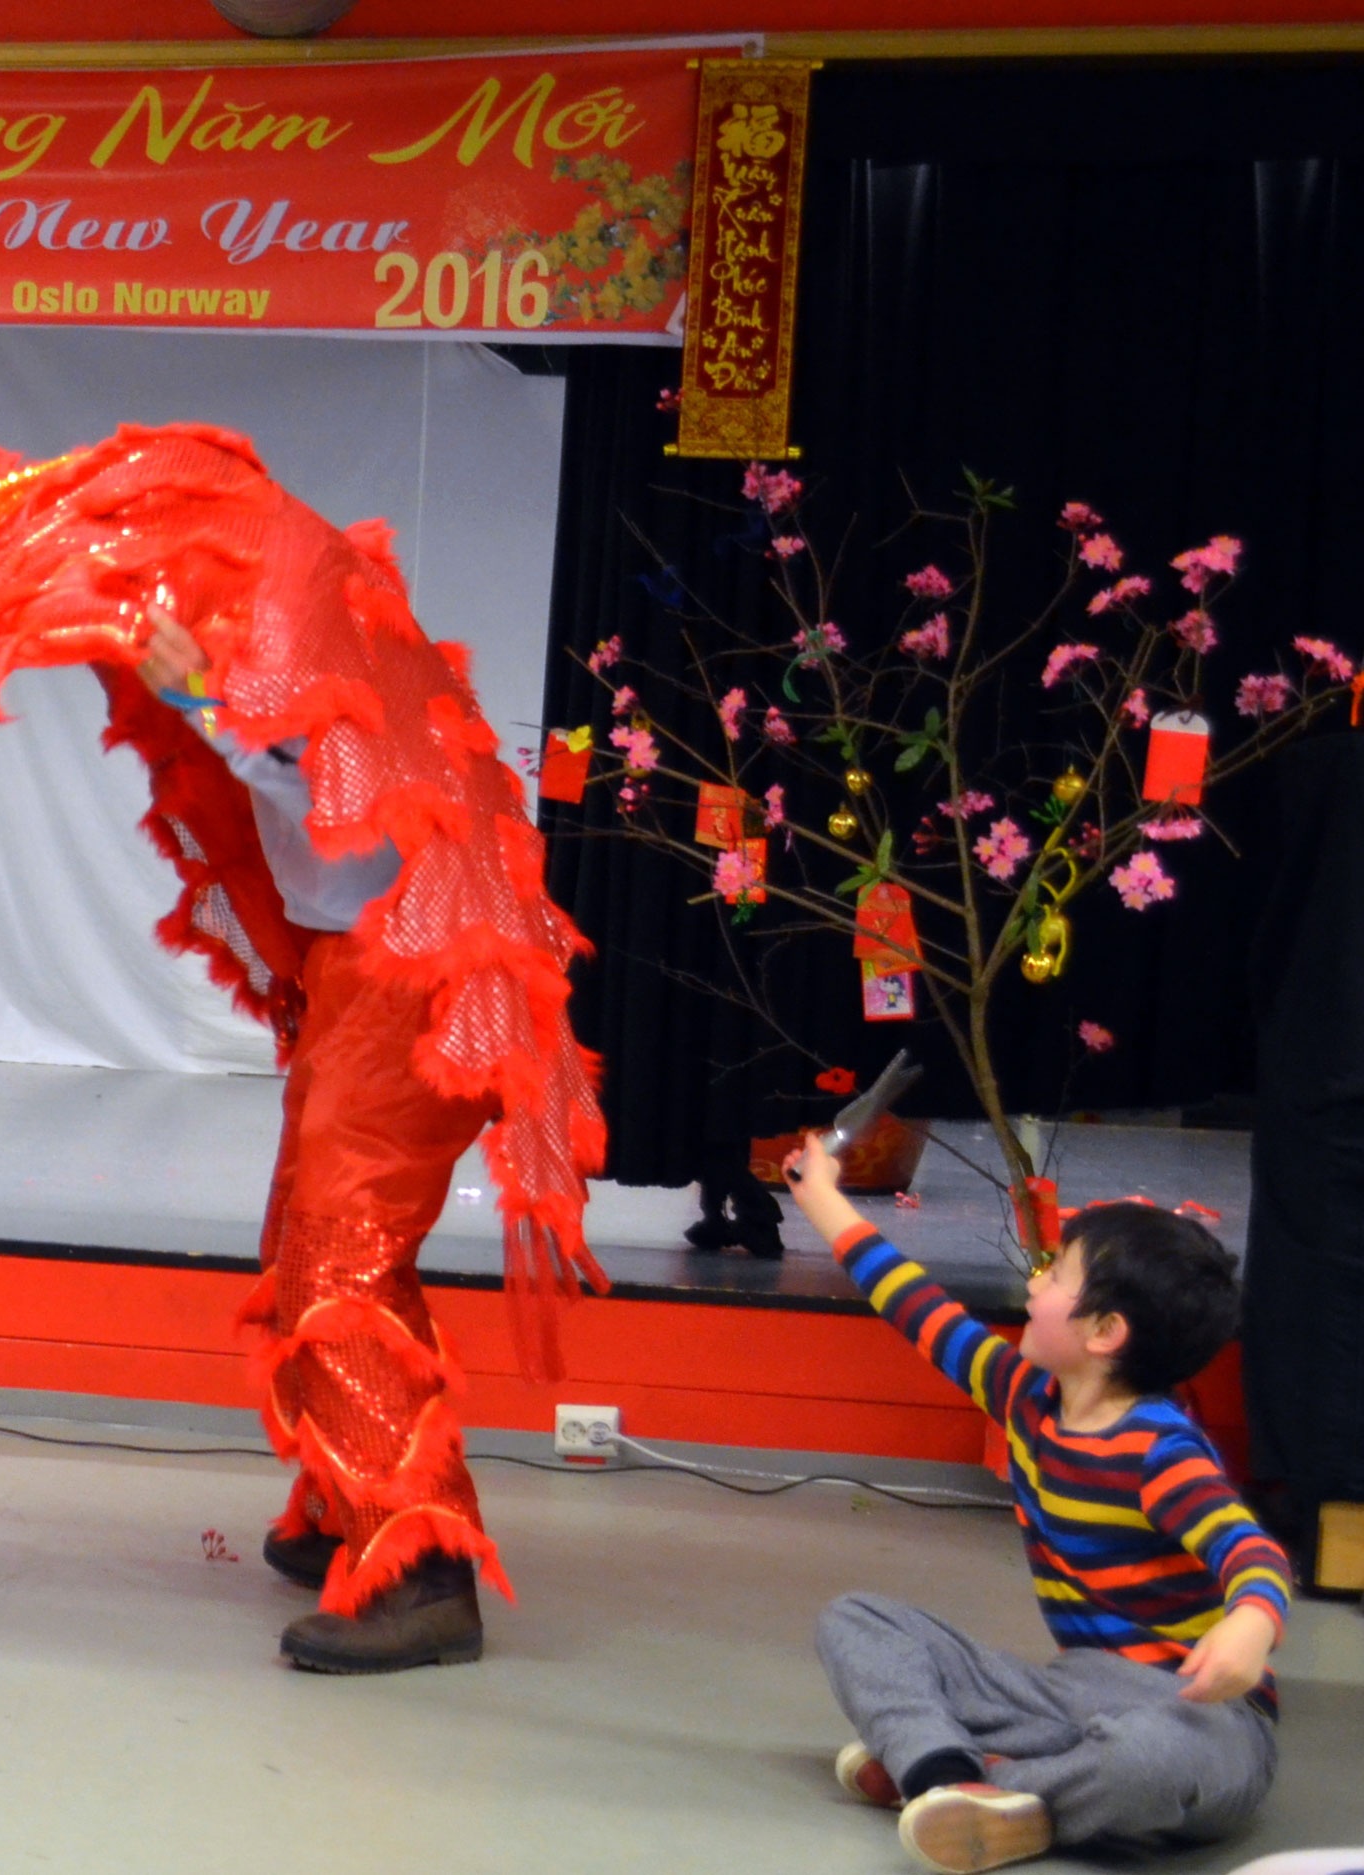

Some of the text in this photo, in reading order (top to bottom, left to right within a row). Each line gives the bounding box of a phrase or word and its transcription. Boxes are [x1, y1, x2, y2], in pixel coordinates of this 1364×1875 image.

[89, 75, 354, 169] Năm
[367, 71, 647, 169] Mới
[716, 103, 786, 158] 福
[200, 199, 410, 264] Year
[12, 281, 99, 314] Oslo
[113, 282, 271, 320] Norway
[374, 250, 551, 330] 2016
